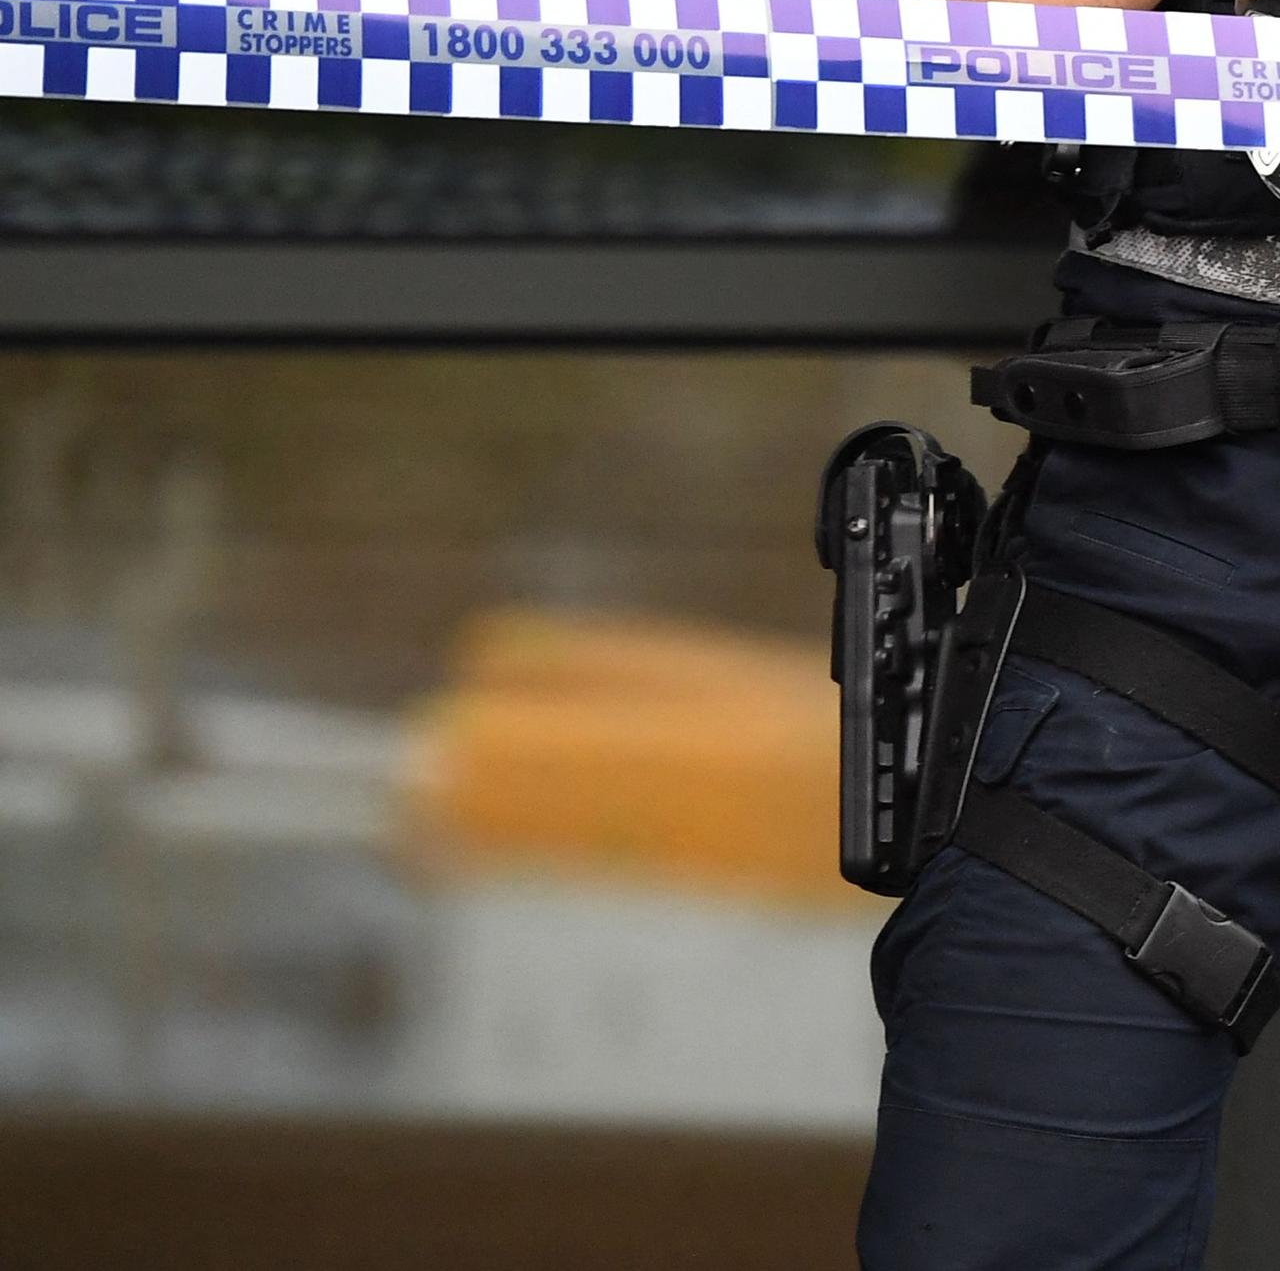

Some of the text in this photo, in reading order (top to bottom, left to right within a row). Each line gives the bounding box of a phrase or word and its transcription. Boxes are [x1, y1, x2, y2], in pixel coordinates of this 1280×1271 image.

[237, 9, 350, 35] CRIME
[240, 33, 353, 56] STOPPERS
[423, 22, 711, 70] 1800 333 000
[919, 47, 1158, 90] POLICE
